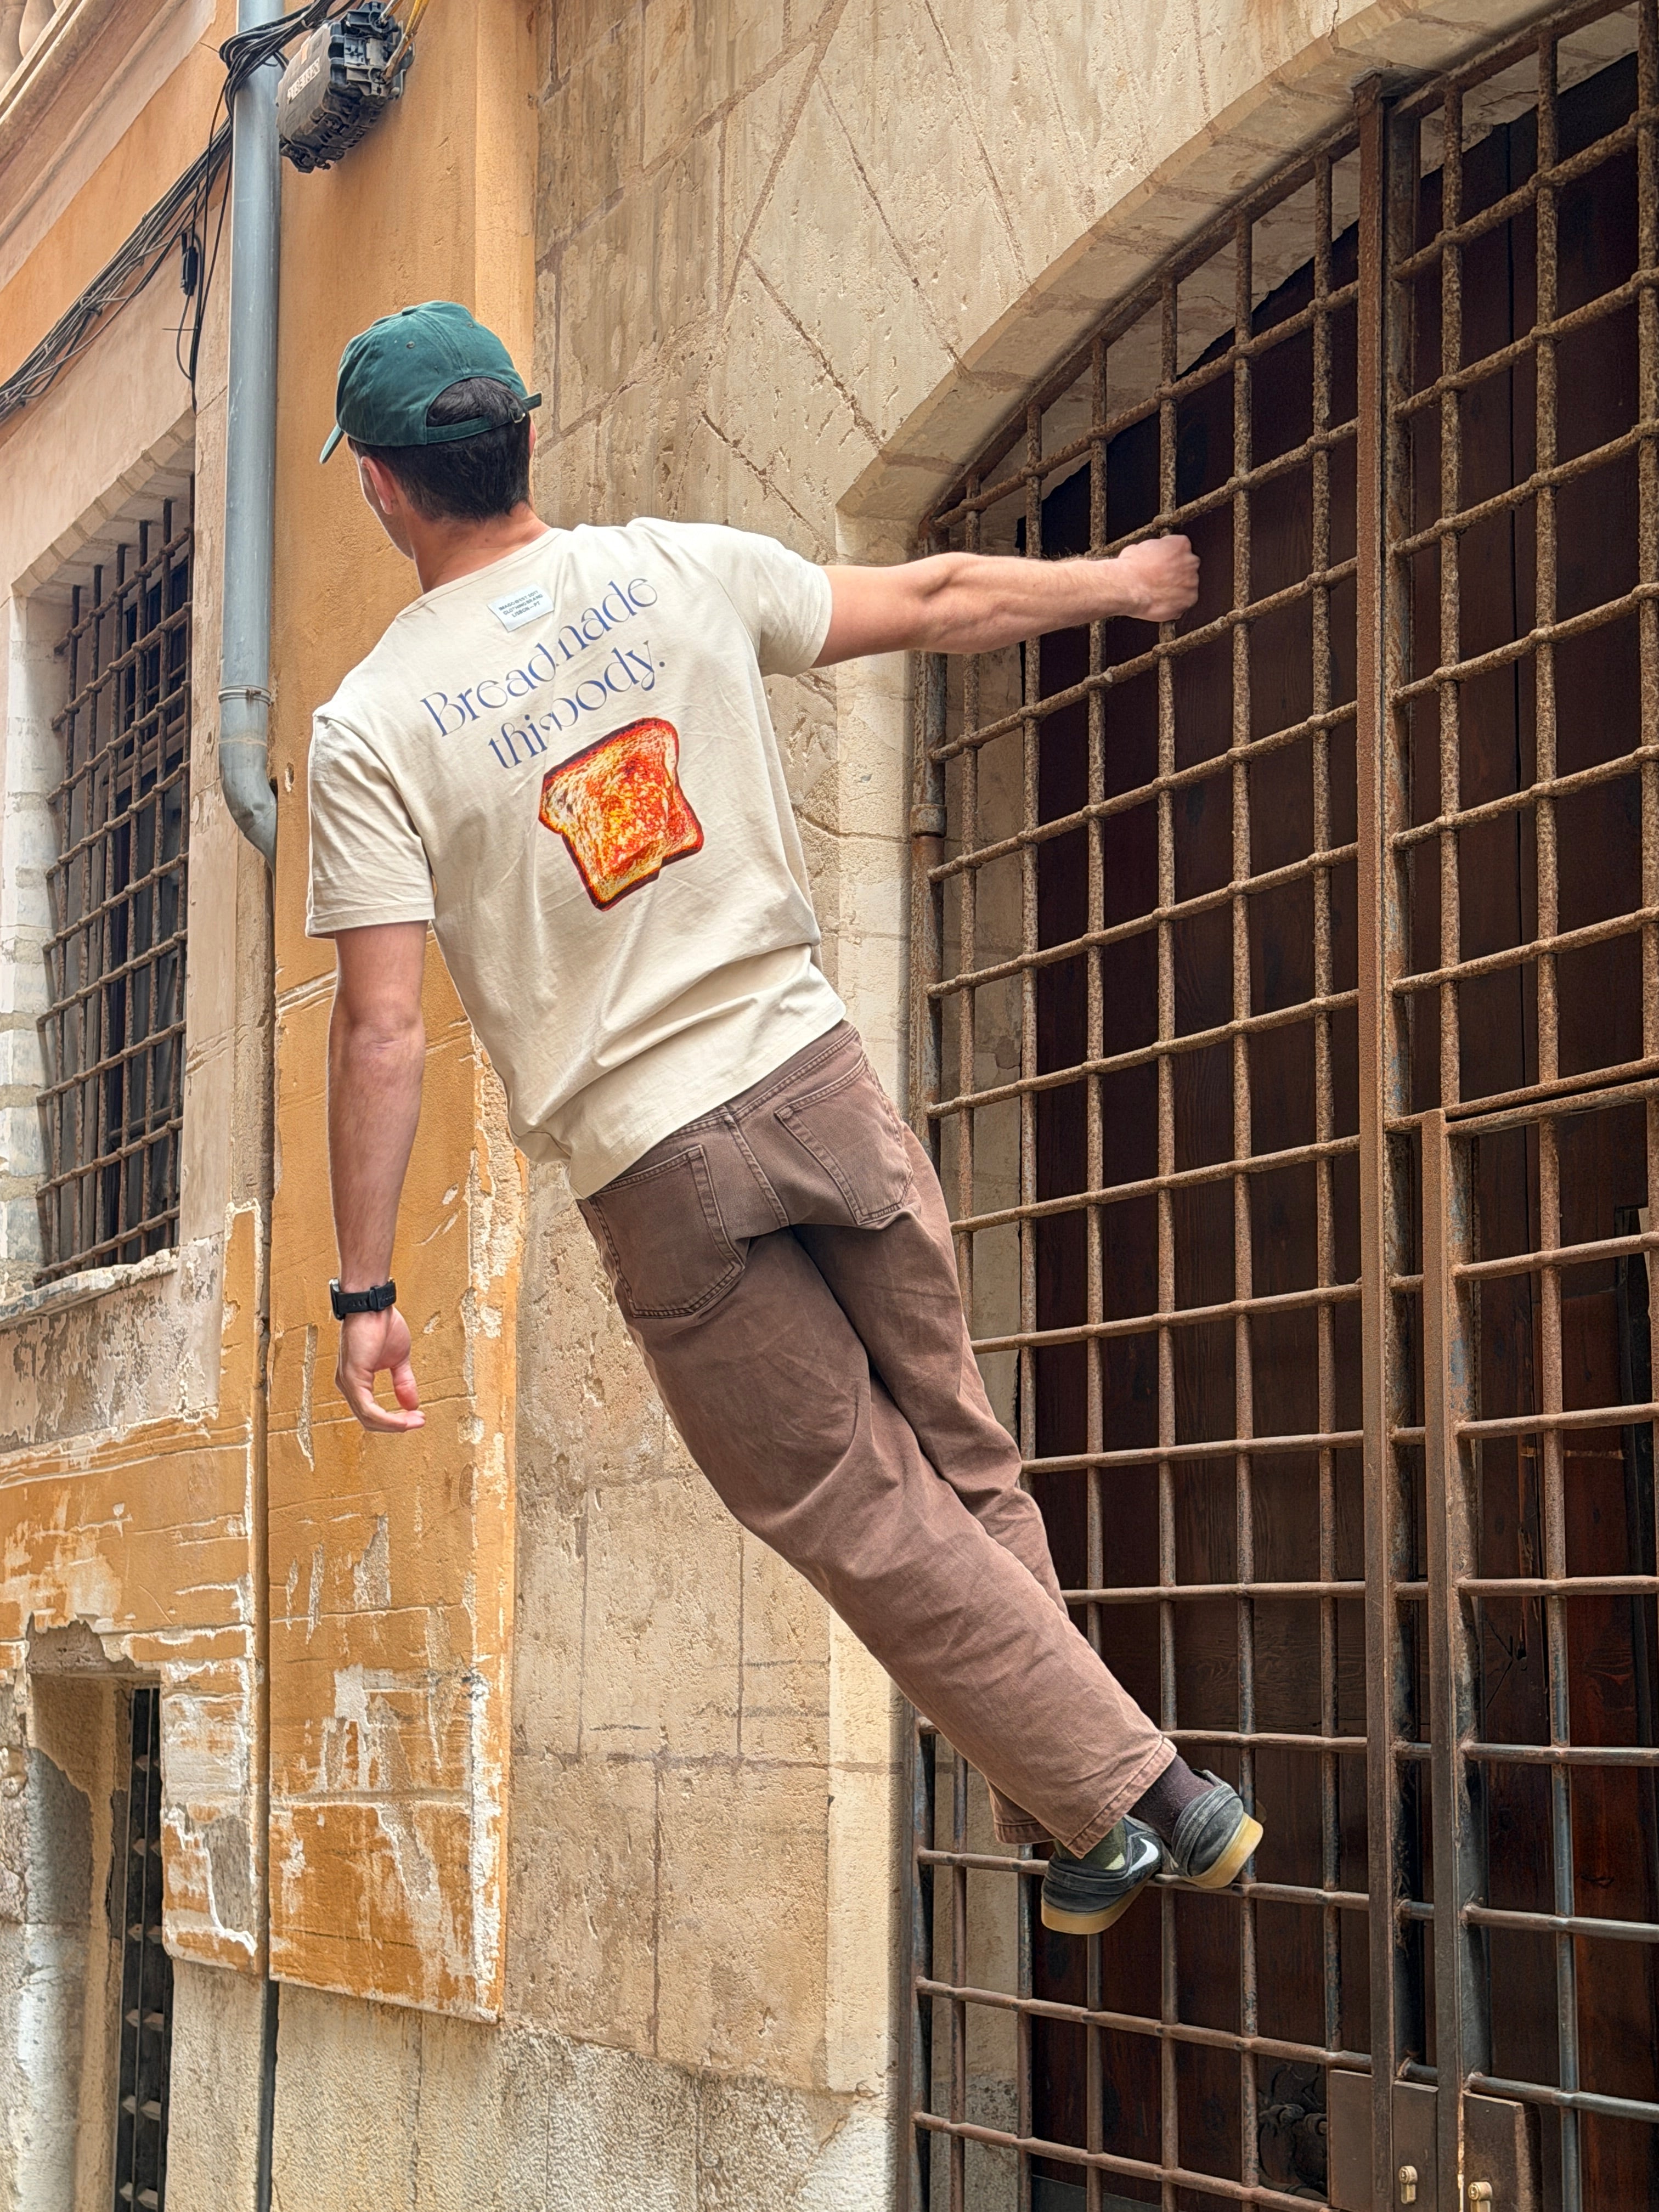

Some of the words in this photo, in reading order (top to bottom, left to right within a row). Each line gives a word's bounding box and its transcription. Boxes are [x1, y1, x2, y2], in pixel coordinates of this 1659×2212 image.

[503, 602, 527, 616] CLOTHING
[526, 594, 543, 605] BRAND
[511, 607, 530, 618] LISBON
[420, 642, 556, 737] Bread
